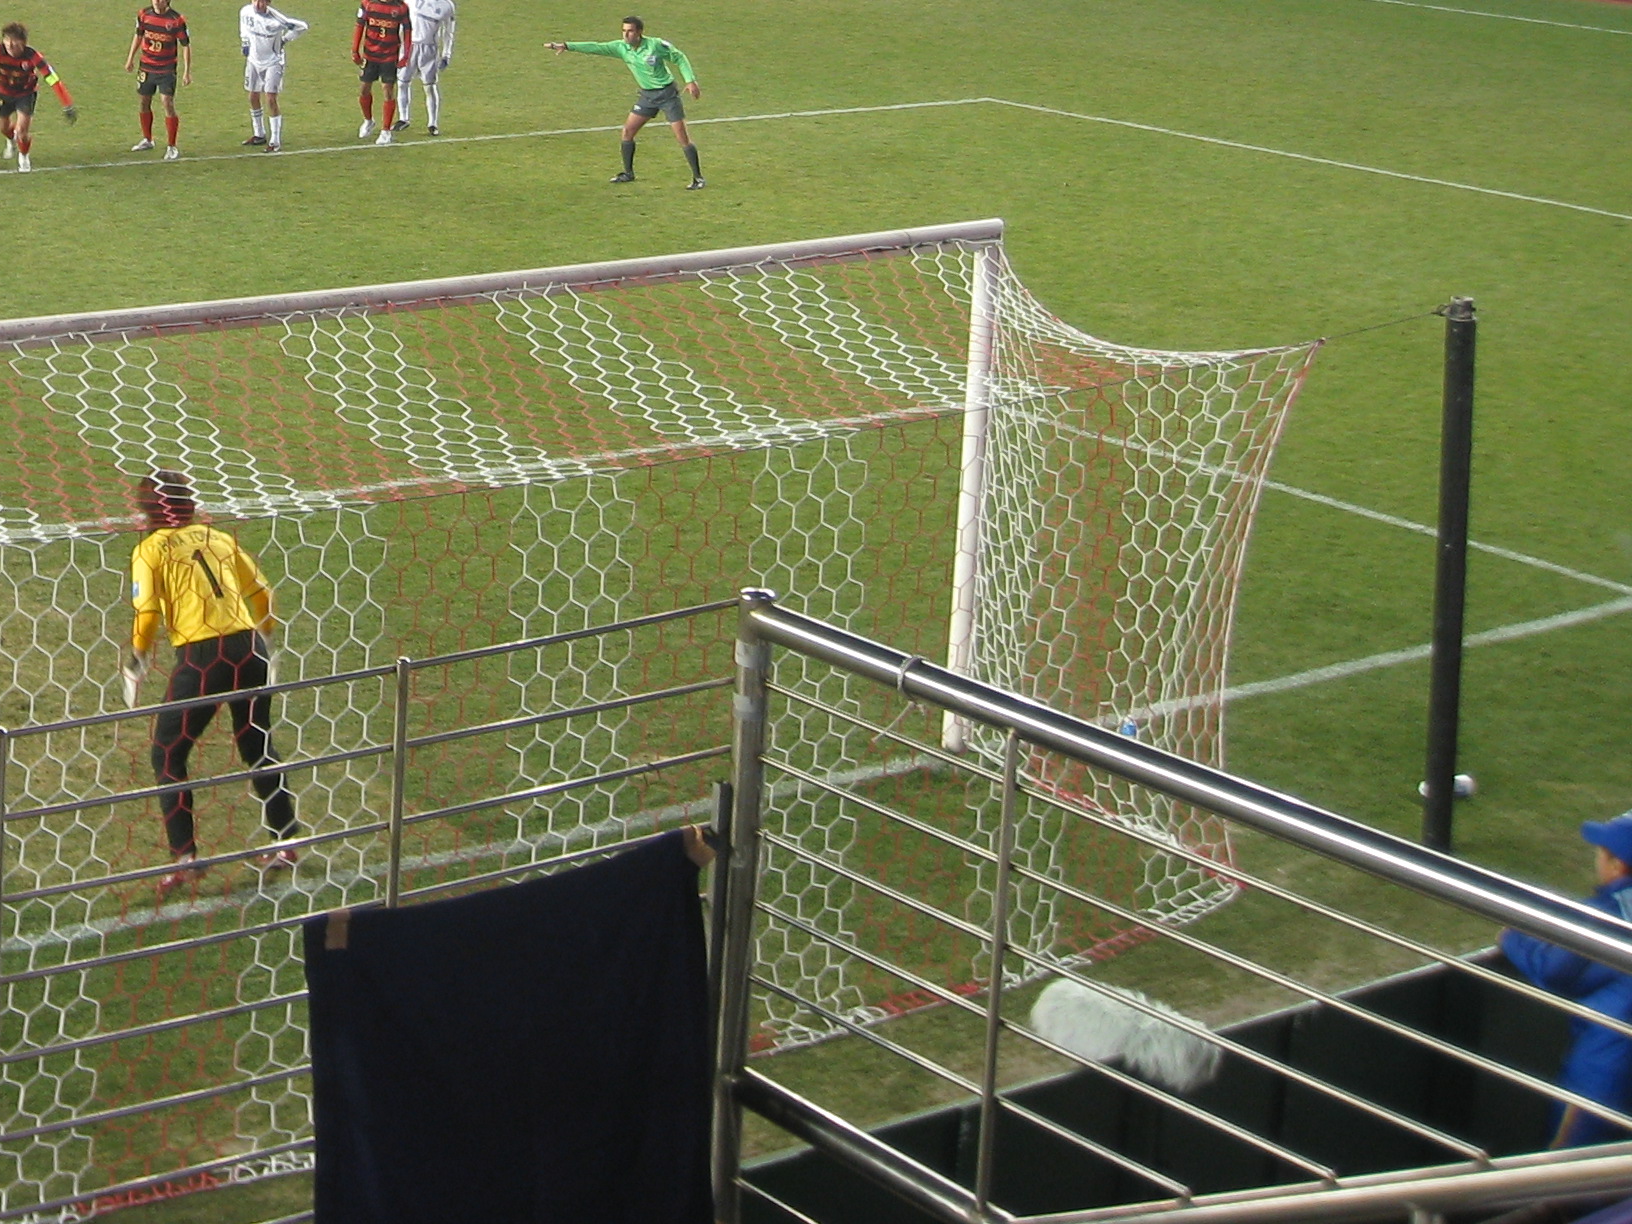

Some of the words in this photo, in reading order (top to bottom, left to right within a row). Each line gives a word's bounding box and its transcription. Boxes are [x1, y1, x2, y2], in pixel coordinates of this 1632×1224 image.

[378, 27, 387, 39] 3
[148, 39, 163, 53] 29
[191, 548, 225, 599] 1
